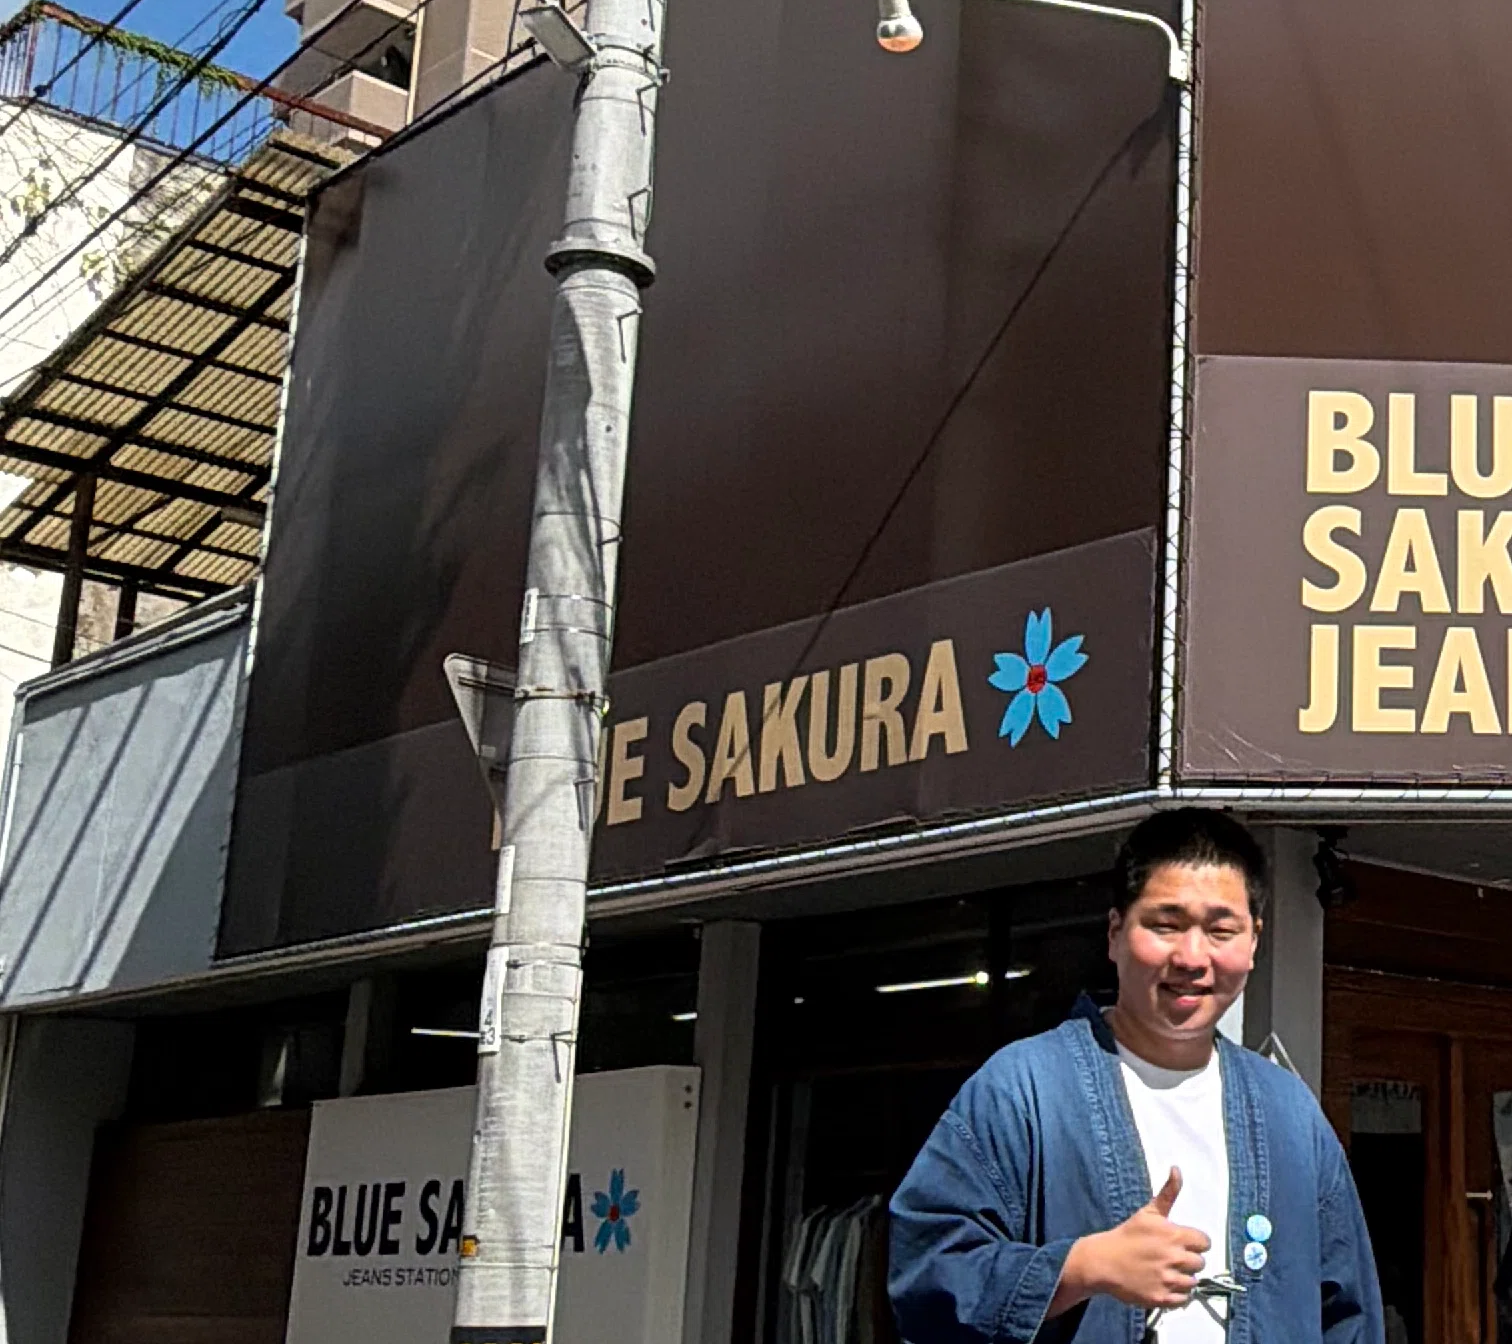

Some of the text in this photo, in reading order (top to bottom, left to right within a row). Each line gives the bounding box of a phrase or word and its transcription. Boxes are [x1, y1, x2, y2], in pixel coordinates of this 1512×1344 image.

[667, 638, 968, 812] SAKURA
[306, 1173, 586, 1257] BLUE SAA
[343, 1268, 392, 1287] JEANS
